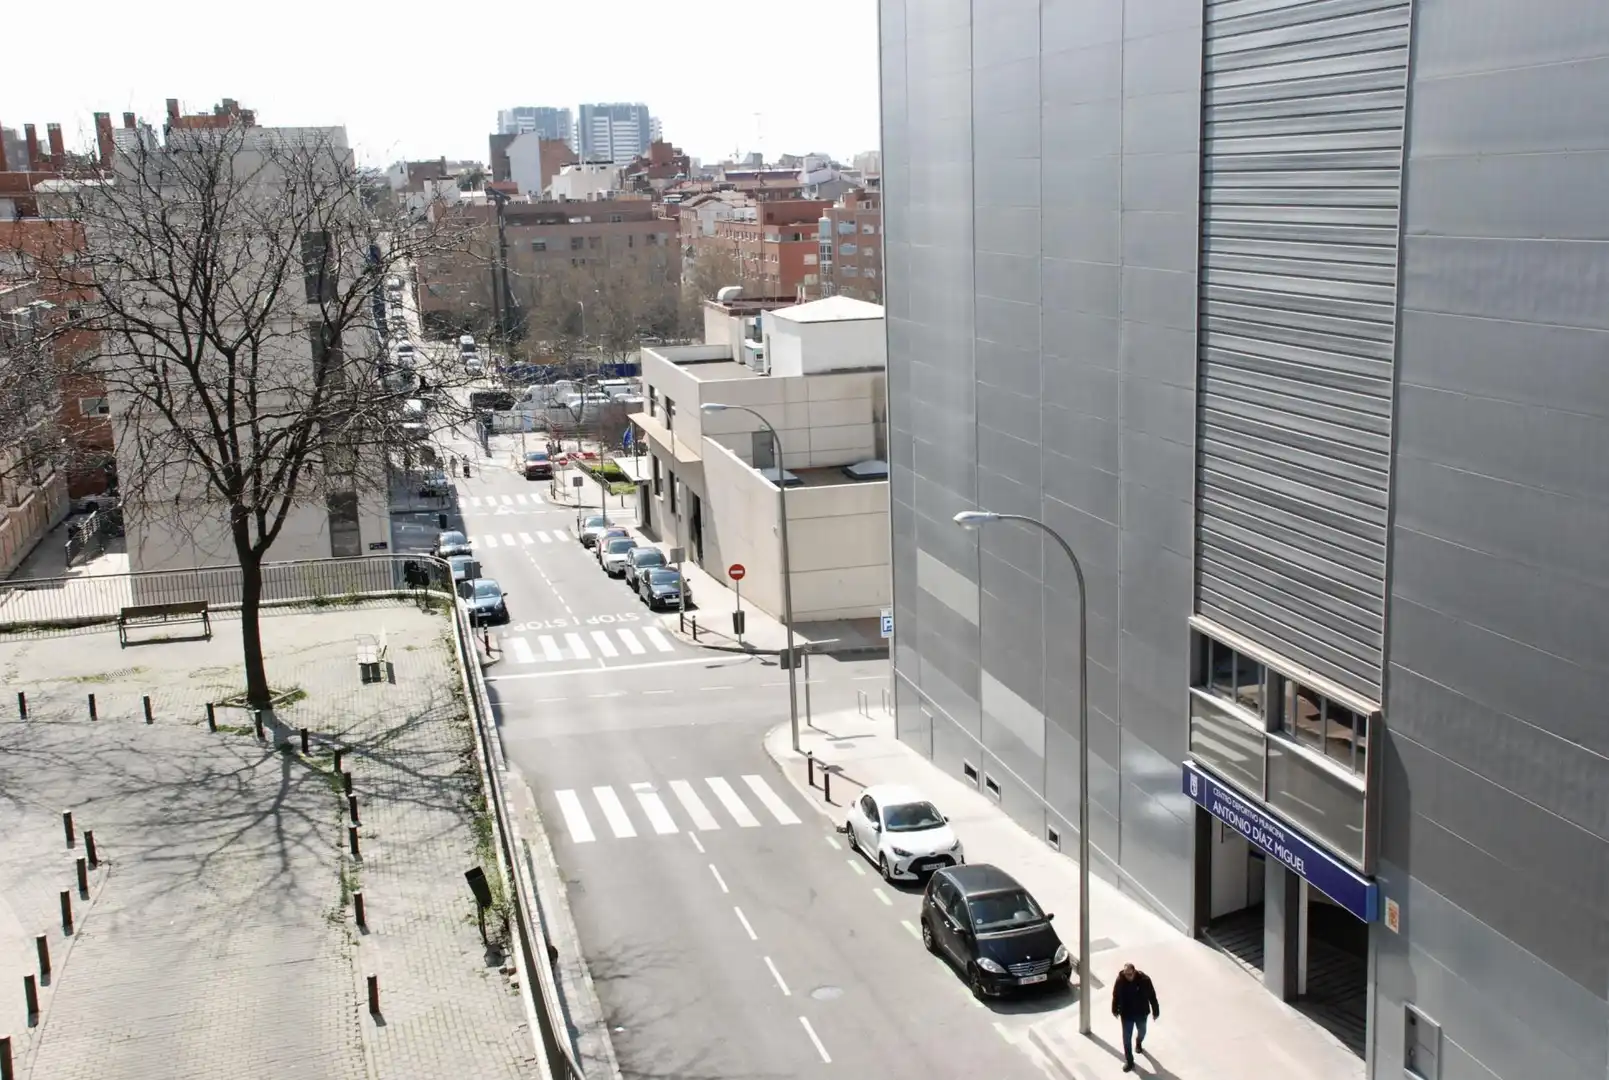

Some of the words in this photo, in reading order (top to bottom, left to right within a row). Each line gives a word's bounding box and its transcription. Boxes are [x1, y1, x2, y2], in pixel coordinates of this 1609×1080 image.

[513, 618, 568, 632] STOP
[586, 612, 640, 625] STOP
[1213, 787, 1231, 805] CENTRO
[1232, 800, 1258, 823] DEPORTIVO
[1258, 817, 1285, 842] MUNICIPAL
[1212, 800, 1251, 834] ANTONIO
[1252, 827, 1273, 851] DÍAZ
[1274, 841, 1306, 875] MIGUEL
